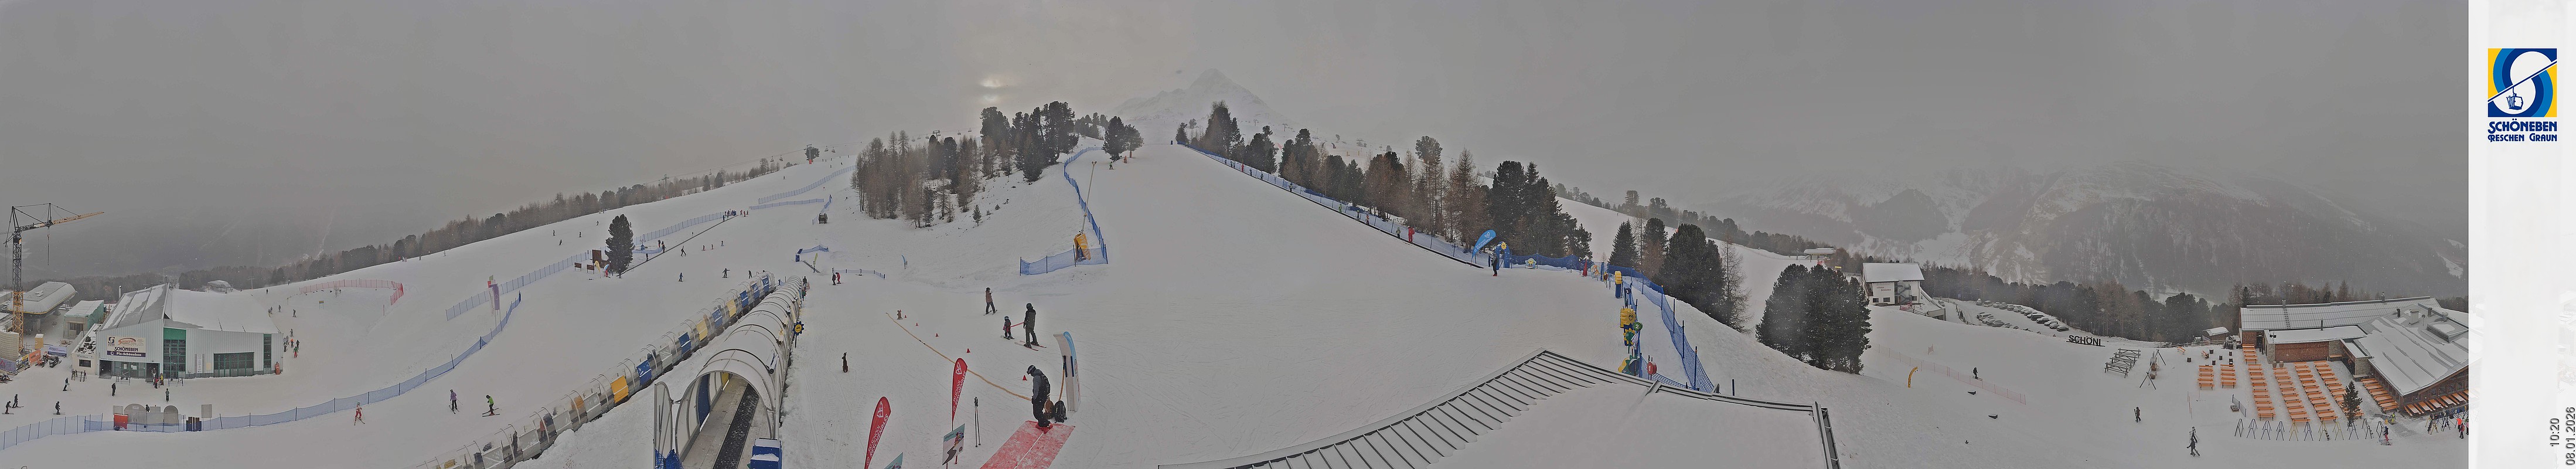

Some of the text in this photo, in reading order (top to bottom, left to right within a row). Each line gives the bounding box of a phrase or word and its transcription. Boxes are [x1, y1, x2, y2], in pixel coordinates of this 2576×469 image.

[2069, 335, 2101, 346] SCHÖNI
[870, 413, 889, 458] RESCHENPASS
[871, 424, 880, 445] SCHOOL
